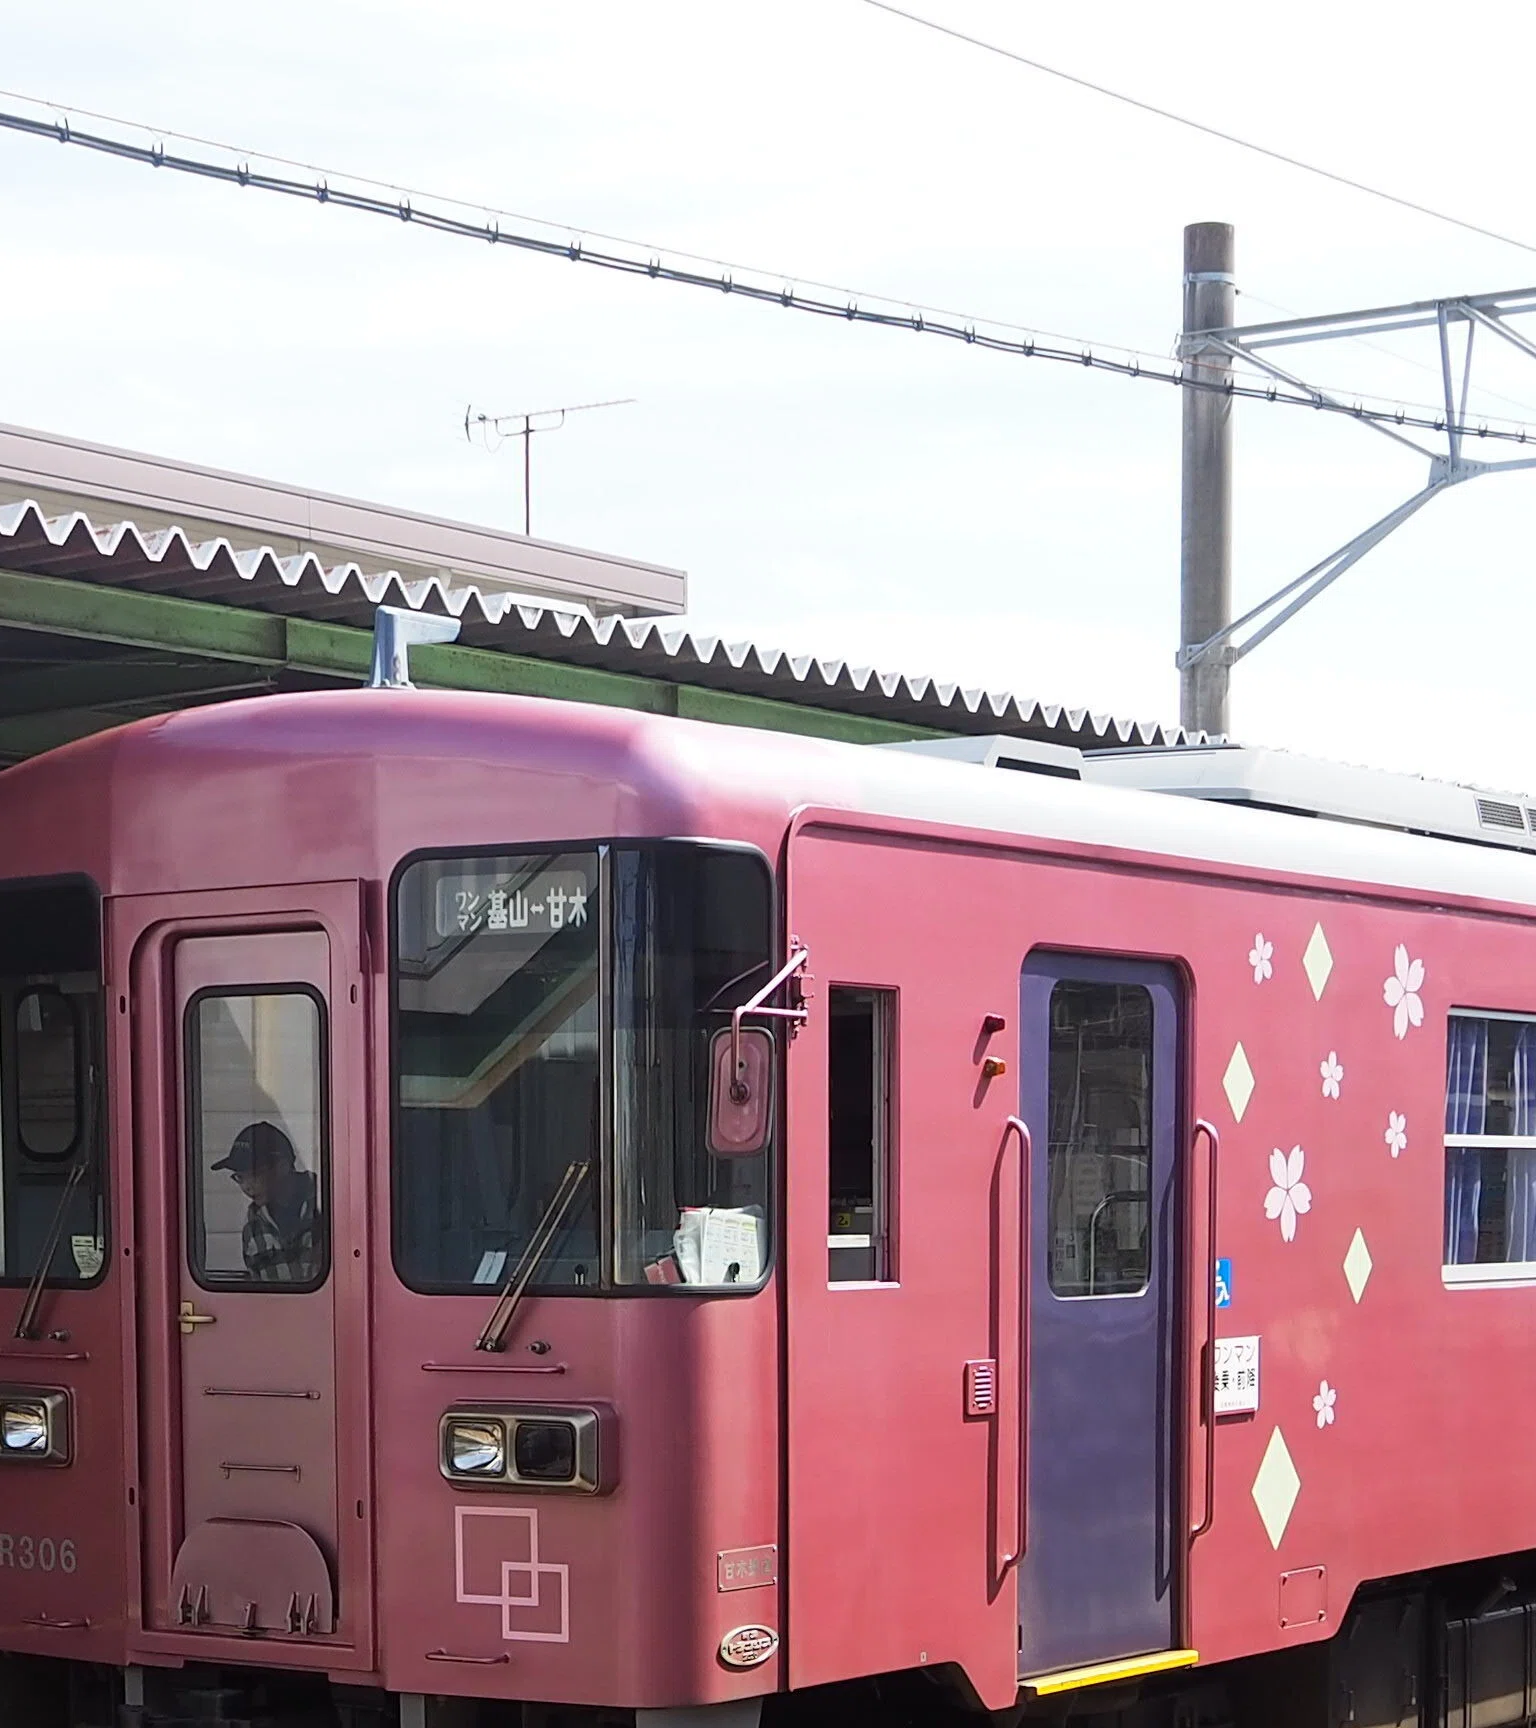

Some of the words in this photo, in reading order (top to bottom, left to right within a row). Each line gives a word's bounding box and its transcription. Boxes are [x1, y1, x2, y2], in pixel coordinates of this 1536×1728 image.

[455, 890, 481, 912] ワン
[487, 889, 529, 930] 基山
[546, 886, 588, 929] 甘木
[457, 913, 483, 932] マン
